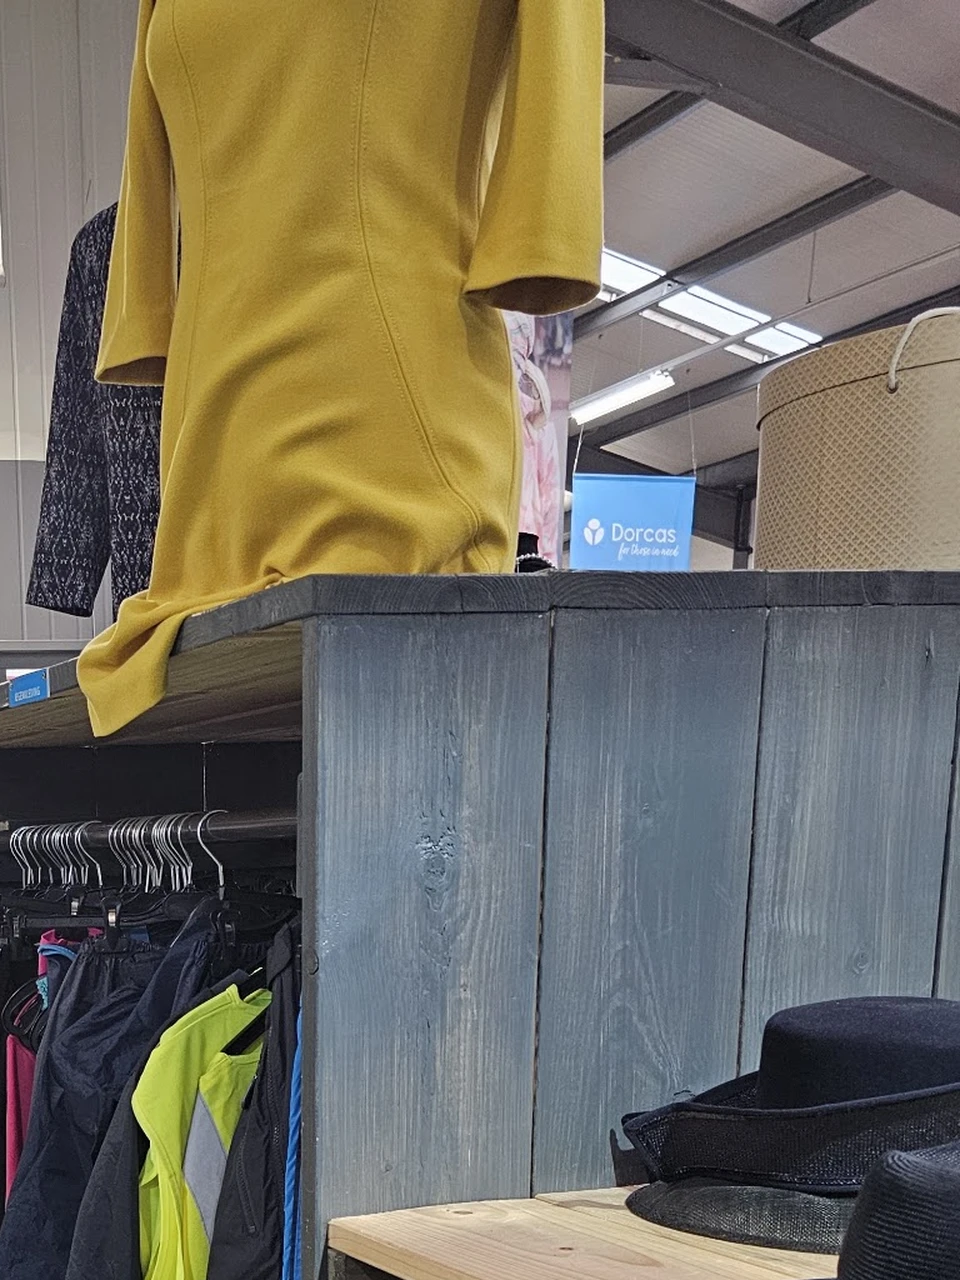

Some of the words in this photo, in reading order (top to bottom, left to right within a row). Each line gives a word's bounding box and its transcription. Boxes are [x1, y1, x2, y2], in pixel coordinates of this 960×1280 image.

[611, 523, 677, 543] Dorcas
[618, 542, 630, 561] for
[660, 545, 680, 557] need
